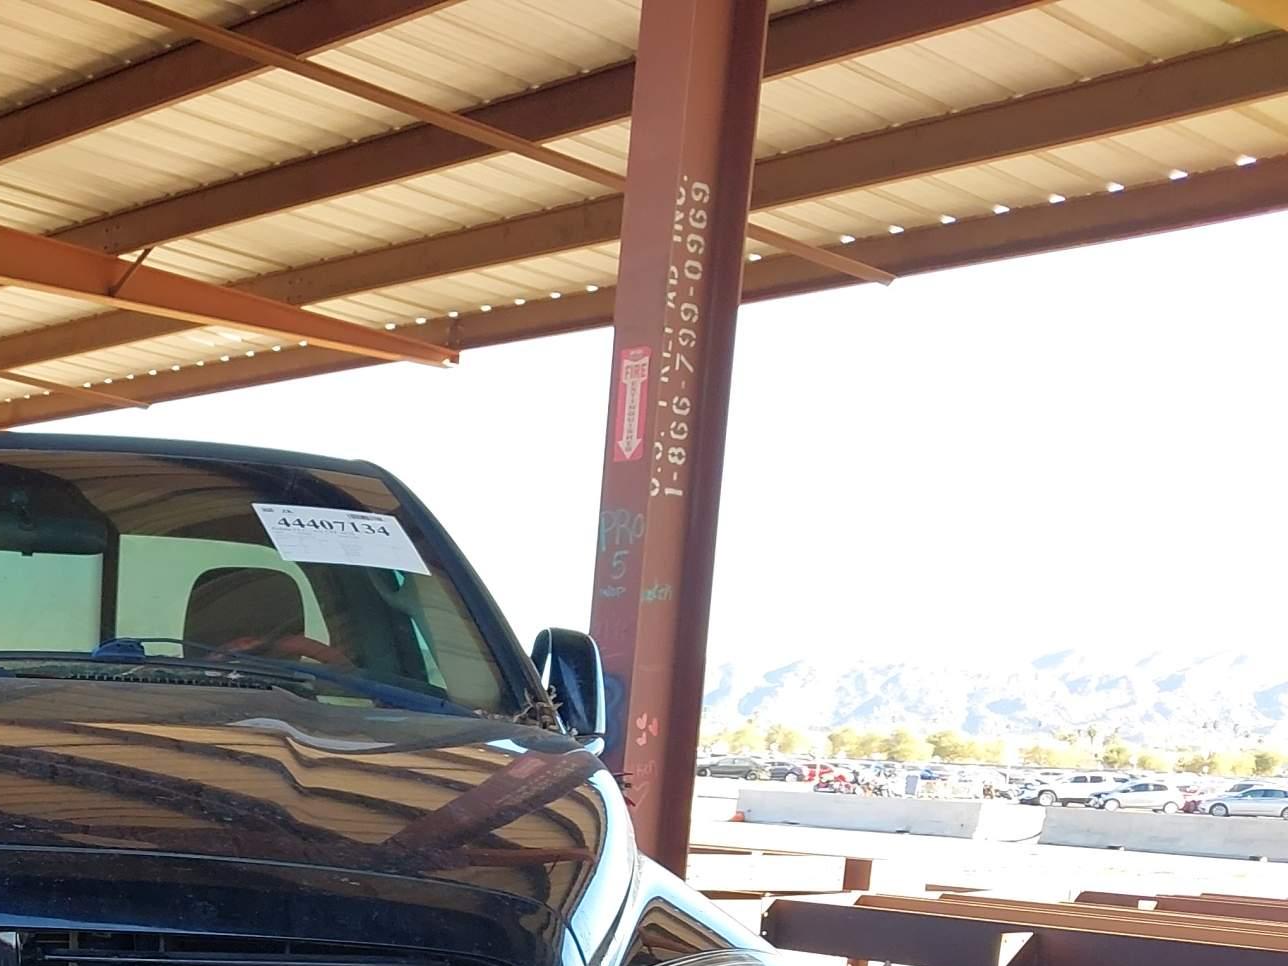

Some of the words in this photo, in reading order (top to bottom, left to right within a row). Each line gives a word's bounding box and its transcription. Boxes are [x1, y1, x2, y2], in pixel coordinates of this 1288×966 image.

[664, 181, 710, 496] 1-866-799-0969
[625, 363, 647, 380] FIRE
[278, 517, 391, 537] 44407134
